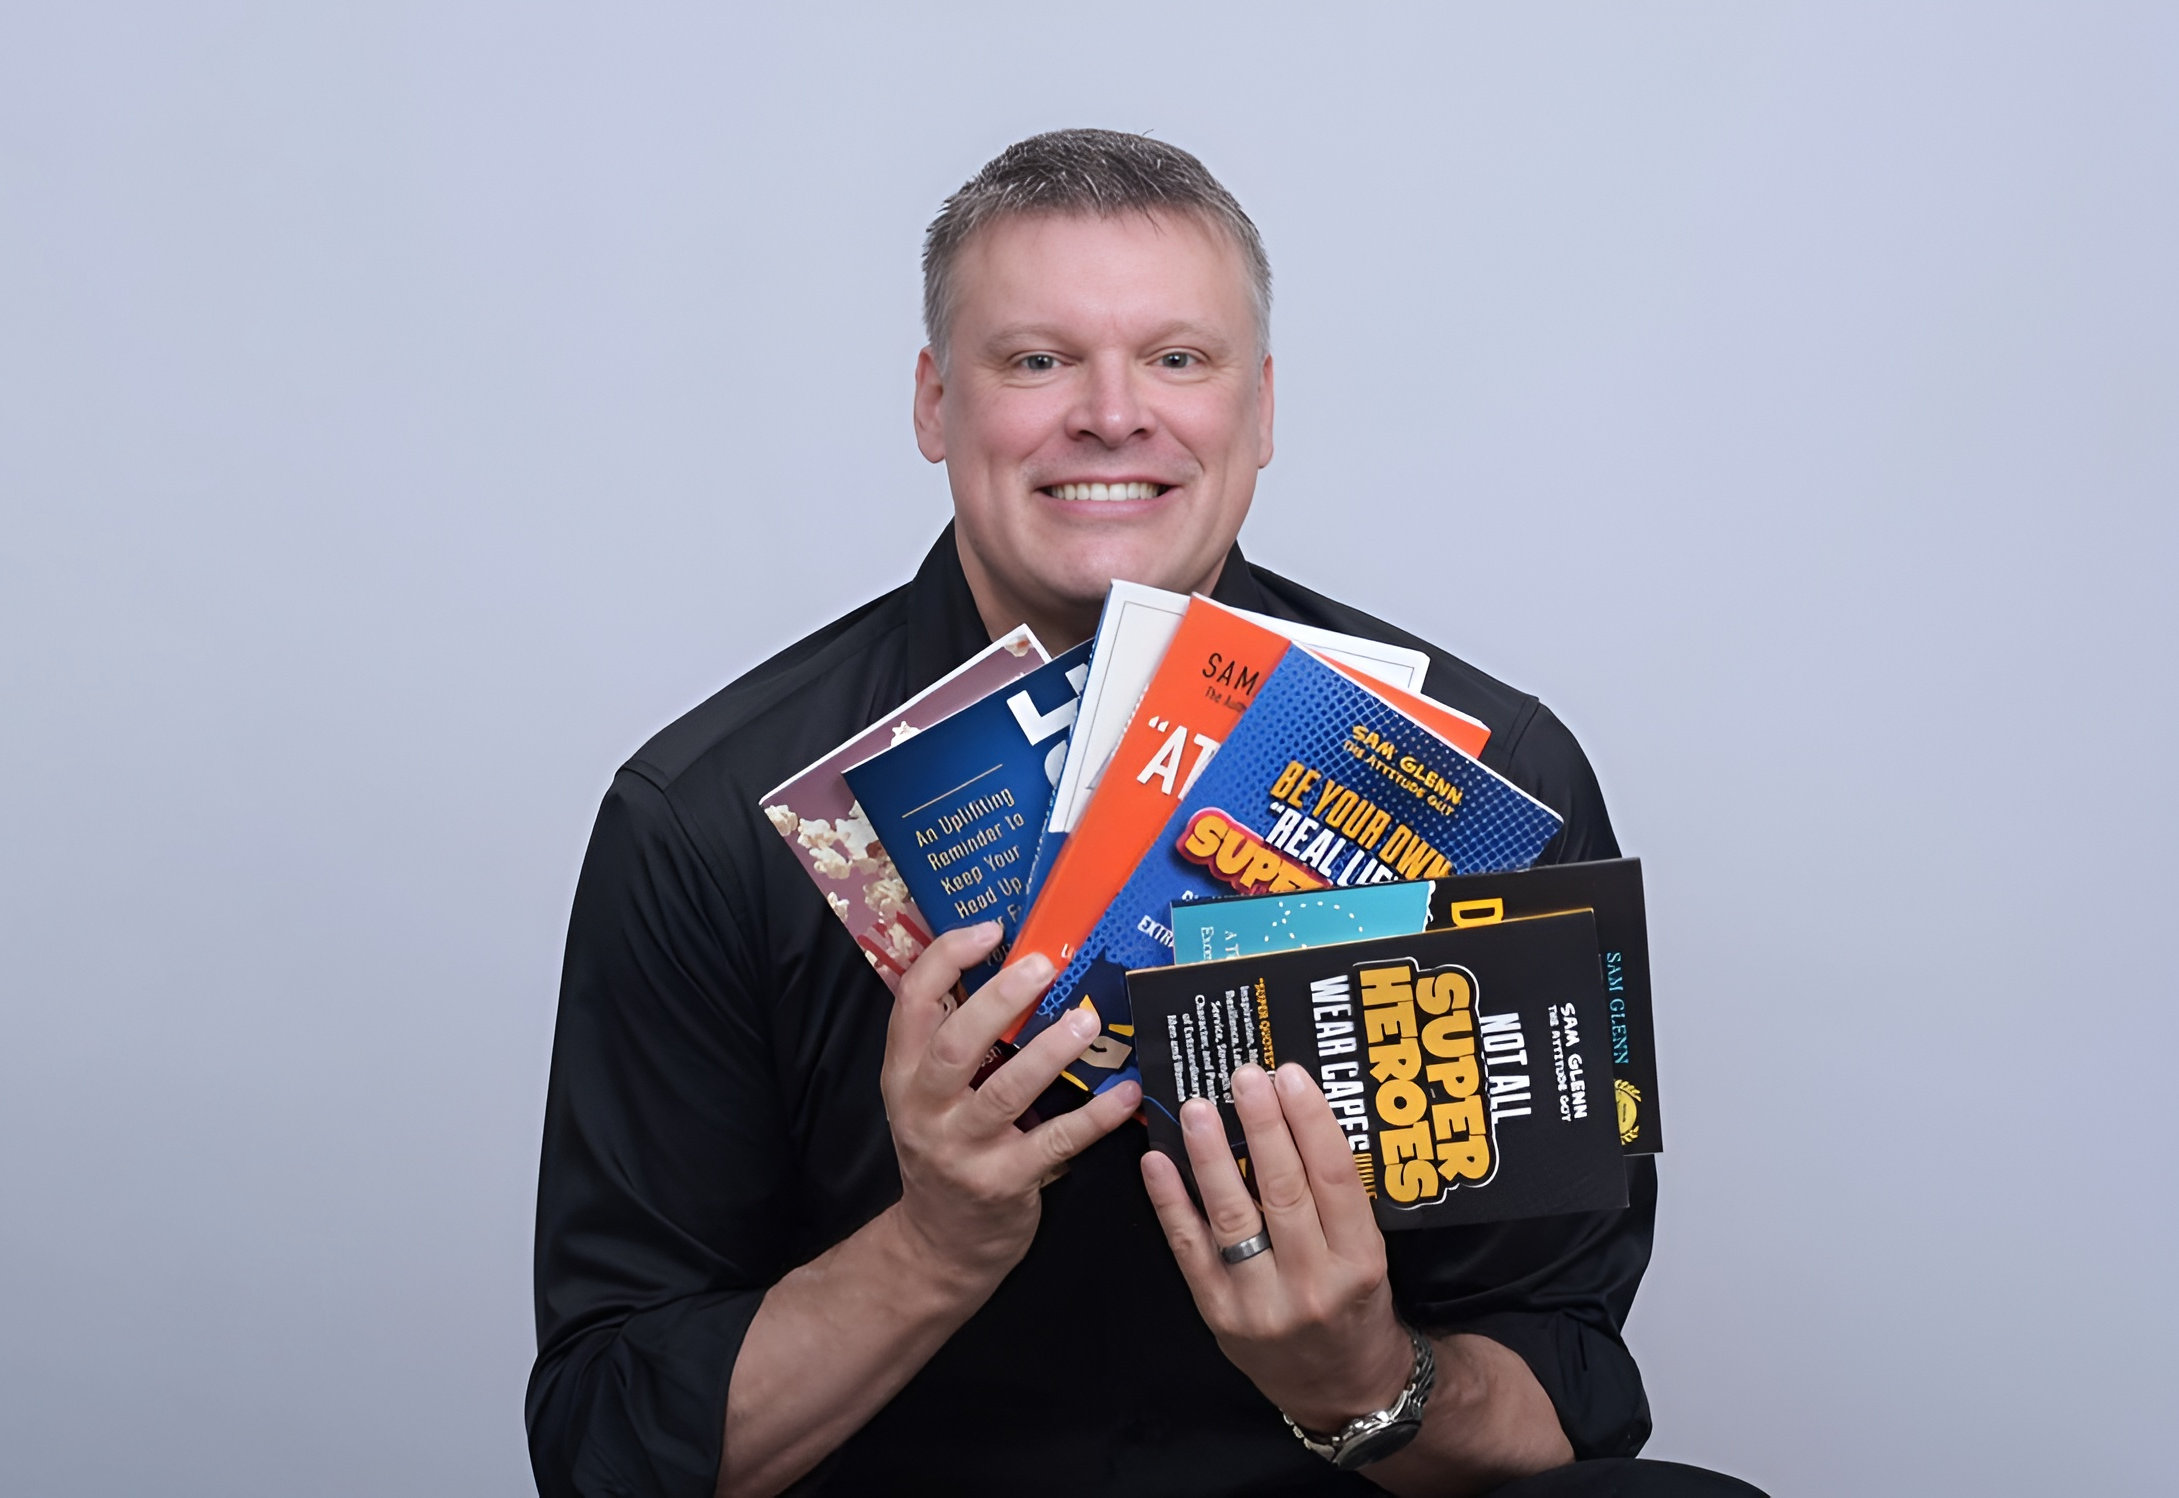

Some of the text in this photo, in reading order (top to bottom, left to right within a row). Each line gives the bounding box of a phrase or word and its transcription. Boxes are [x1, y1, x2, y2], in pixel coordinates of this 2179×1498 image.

[1202, 652, 1260, 696] SAM
[1352, 725, 1463, 805] SAM GLENN
[1365, 754, 1428, 798] ATTITUDE
[915, 788, 1015, 847] An Uplifting
[1270, 760, 1321, 809] BE
[1312, 779, 1391, 850] YOUR
[927, 824, 1004, 871] Reminder
[940, 845, 1020, 895] Keep Your
[997, 876, 1022, 896] Up
[1310, 974, 1358, 1057] WEAR
[1548, 1004, 1560, 1027] THE
[1606, 952, 1629, 1065] SAM GLENN
[1359, 965, 1439, 1203] HEROES
[1415, 972, 1490, 1181] SUPER
[1480, 1012, 1532, 1124] NOT ALL
[1551, 1030, 1567, 1092] ATTITUDE
[1560, 1002, 1588, 1119] SAM GLENN
